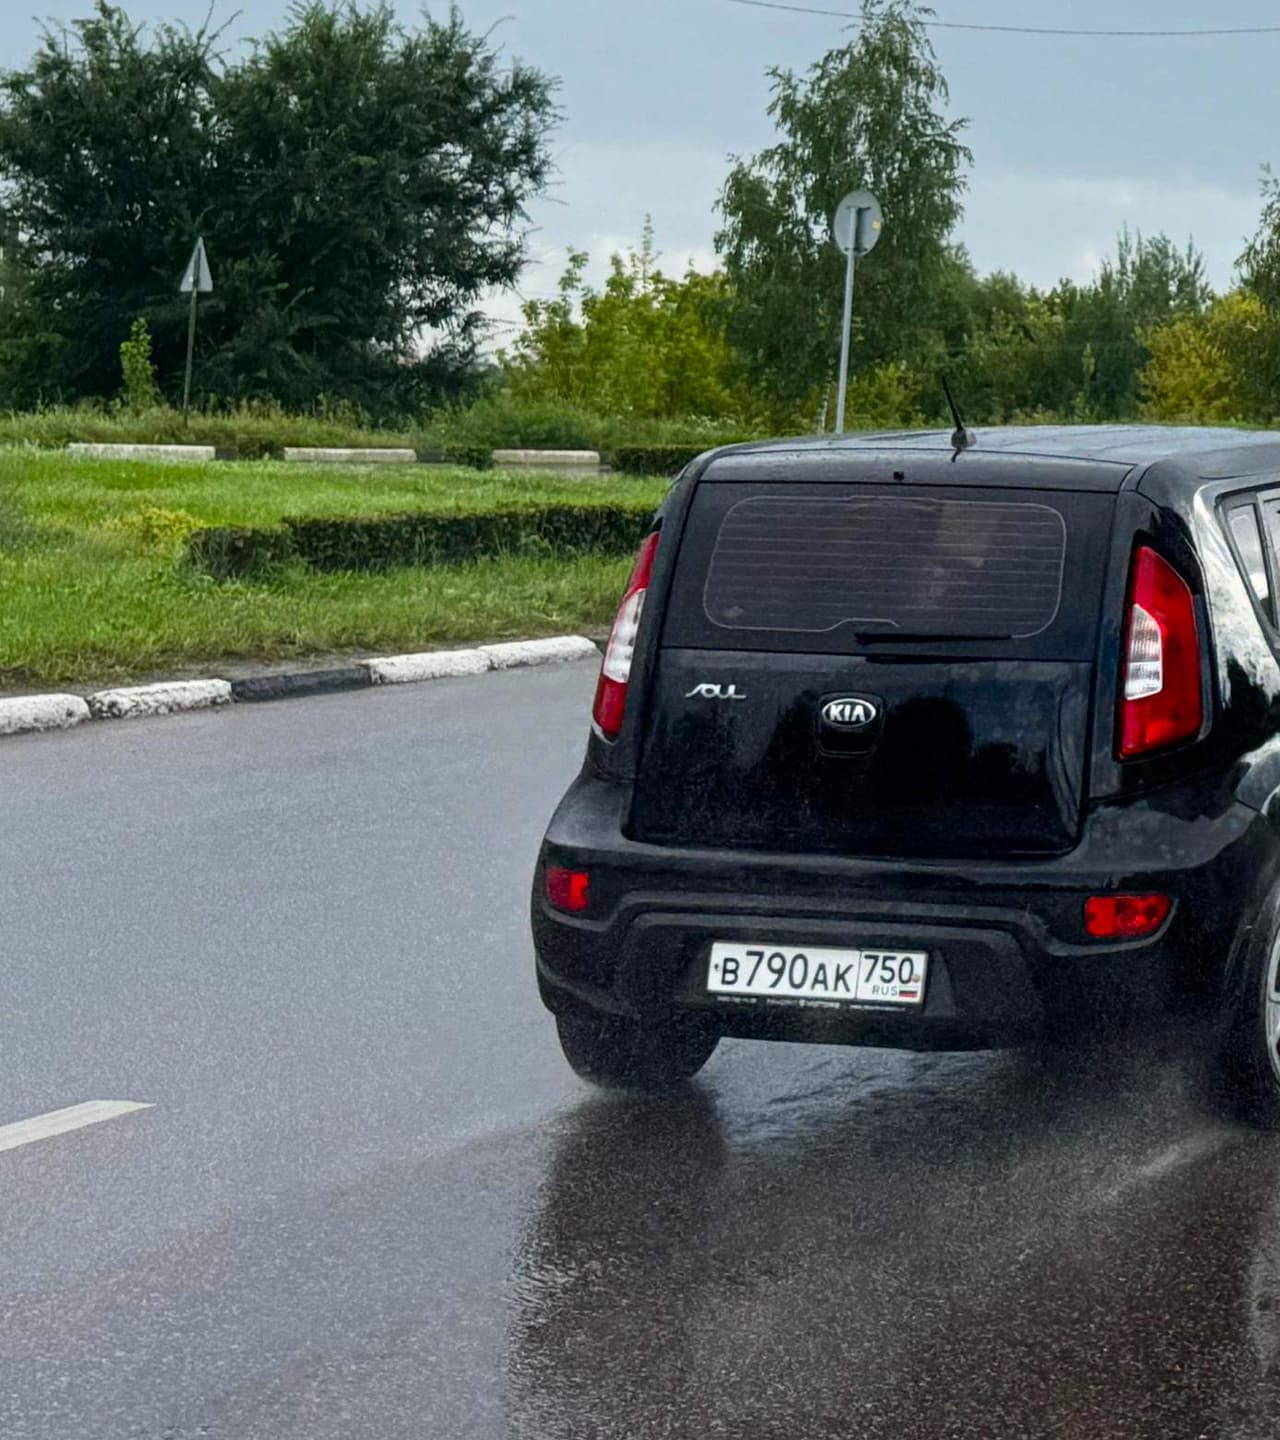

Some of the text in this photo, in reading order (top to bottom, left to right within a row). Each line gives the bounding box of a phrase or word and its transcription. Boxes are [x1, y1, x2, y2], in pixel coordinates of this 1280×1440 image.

[829, 704, 866, 721] KIA
[863, 954, 915, 984] 750
[872, 985, 898, 997] RUS
